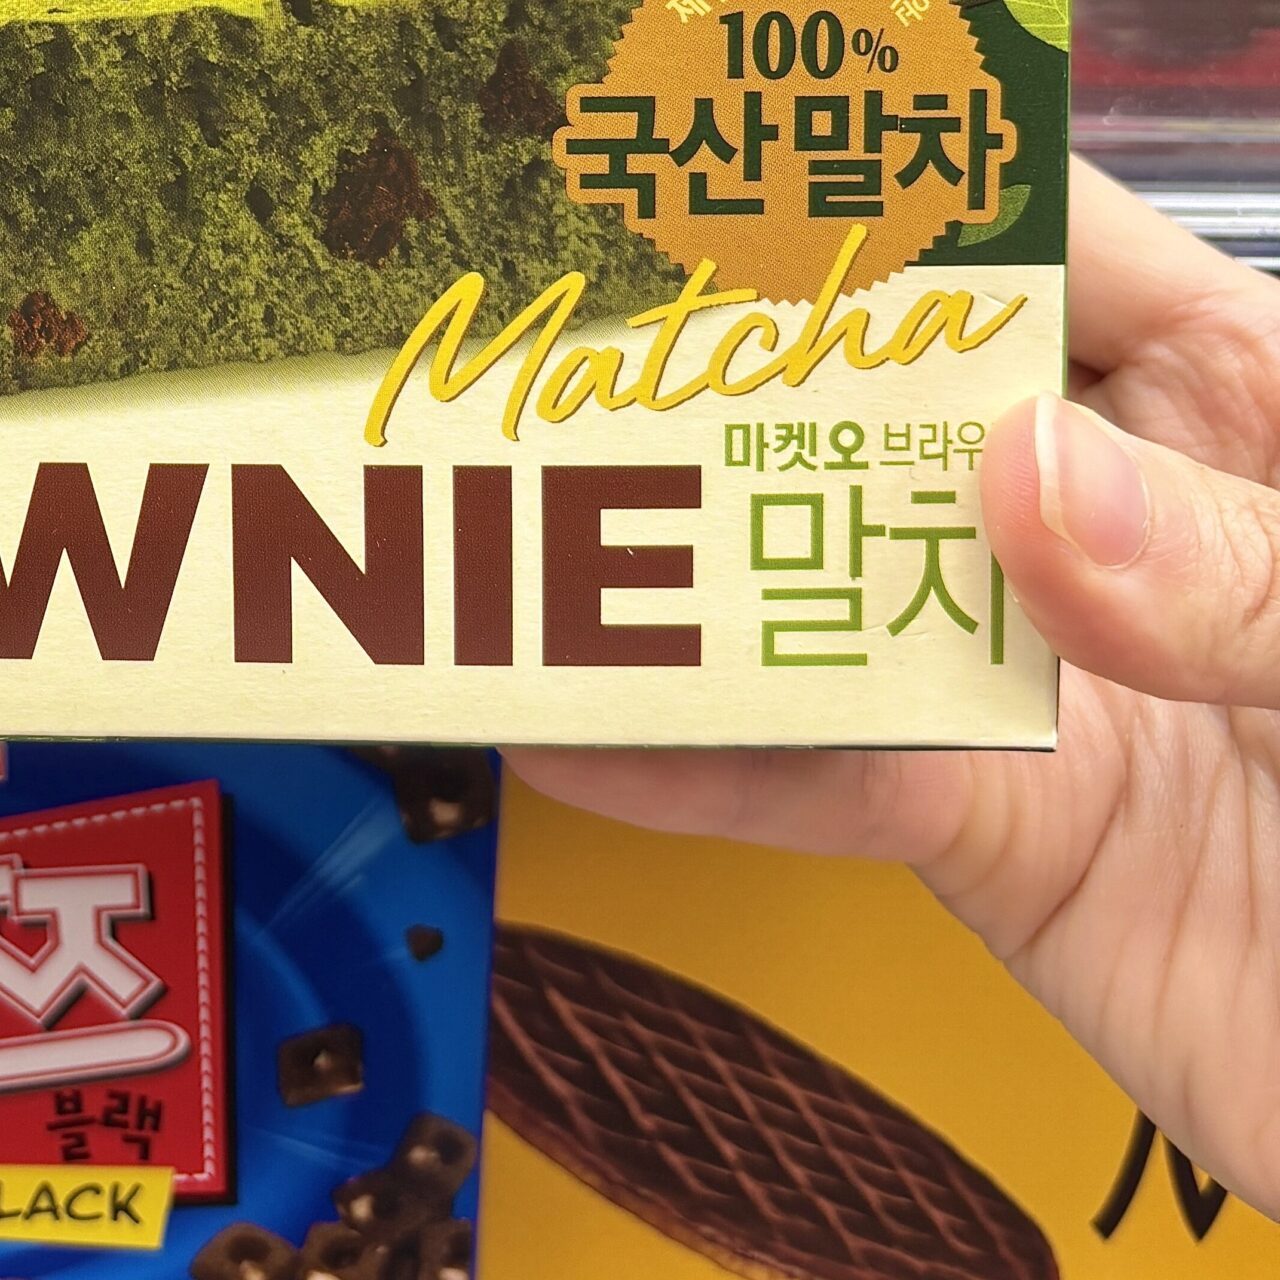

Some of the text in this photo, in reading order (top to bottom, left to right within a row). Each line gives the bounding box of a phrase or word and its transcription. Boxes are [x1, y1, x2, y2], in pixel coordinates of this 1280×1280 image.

[365, 223, 1028, 447] Matcha
[724, 420, 992, 472] 마켓오 브라우
[47, 1088, 163, 1163] 블랙
